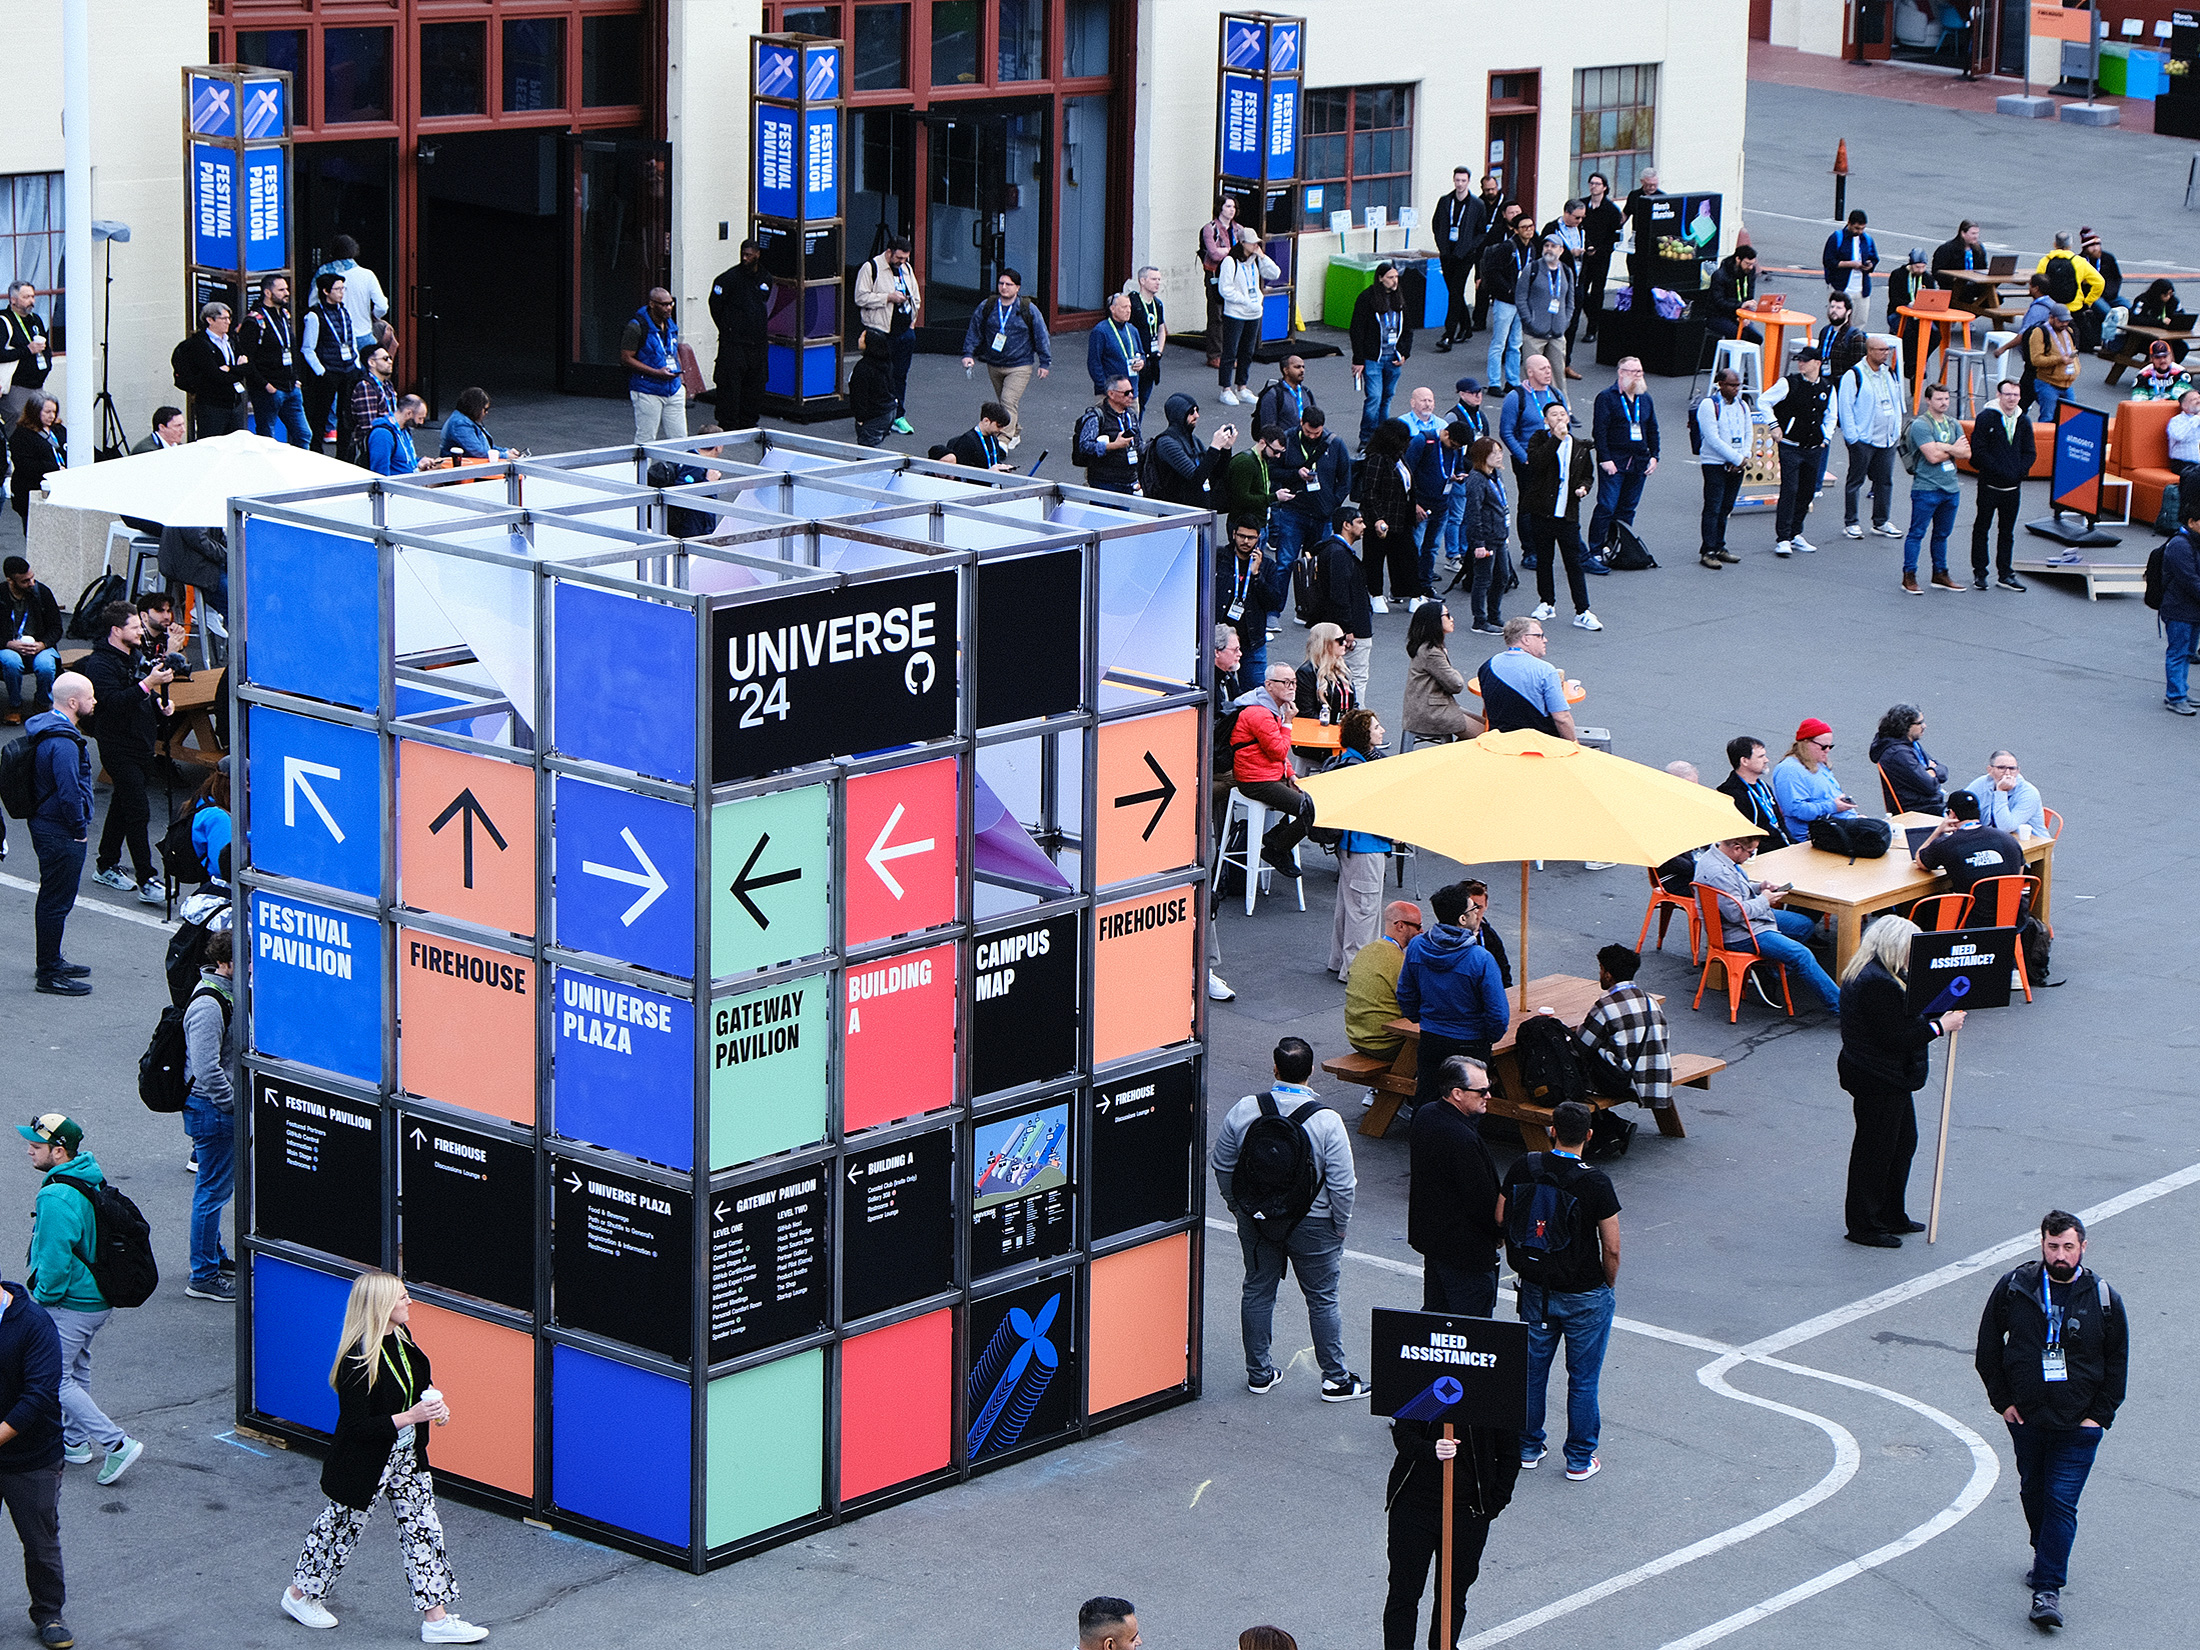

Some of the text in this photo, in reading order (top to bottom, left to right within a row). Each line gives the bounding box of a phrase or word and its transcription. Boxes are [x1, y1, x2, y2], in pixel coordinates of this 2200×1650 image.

[1229, 89, 1243, 152] PAVILION
[1243, 91, 1257, 153] FESTIVAL
[1271, 94, 1283, 155] PAVILION
[1282, 93, 1293, 155] FESTIVAL
[764, 120, 777, 188] PAVILION
[778, 122, 792, 190] FESTIVAL
[809, 124, 820, 192] PAVILION
[822, 124, 832, 192] FESTIVAL
[200, 161, 214, 238] PAVILION
[216, 163, 231, 238] FESTIVAL
[250, 166, 264, 241] PAVILION
[264, 164, 278, 240] FESTIVAL
[729, 602, 936, 681] UNIVERSE
[729, 677, 790, 729] '24
[258, 900, 352, 948] FESTIVAL
[1099, 897, 1187, 942] FIREHOUSE
[259, 932, 352, 980] PAVILION
[410, 940, 526, 994] FIREHOUSE
[976, 929, 1050, 971] CAMPUS
[1930, 954, 1995, 969] ASSISTANCE?
[1952, 944, 1976, 956] NEED
[848, 959, 932, 1004] BUILDING
[976, 970, 1016, 1002] MAP
[563, 978, 671, 1032] UNIVERSE
[716, 990, 804, 1037] GATEWAY
[848, 1008, 860, 1034] A
[563, 1010, 632, 1055] PLAZA
[715, 1023, 799, 1070] PAVILION
[286, 1096, 372, 1130] FESTIVAL PAVILION
[1115, 1084, 1155, 1106] FIREHOUSE
[286, 1139, 312, 1151] Information
[434, 1137, 487, 1163] FIREHOUSE
[868, 1152, 913, 1175] BUILDING A
[588, 1181, 671, 1216] UNIVERSE PLAZA
[588, 1205, 600, 1214] Food
[736, 1178, 816, 1213] GATEWAY PAVILION
[777, 1204, 808, 1220] LEVEL TWO
[713, 1223, 743, 1239] LEVEL ONE
[713, 1290, 737, 1301] Information
[1400, 1345, 1497, 1368] ASSISTANCE?
[1430, 1332, 1467, 1349] NEED
